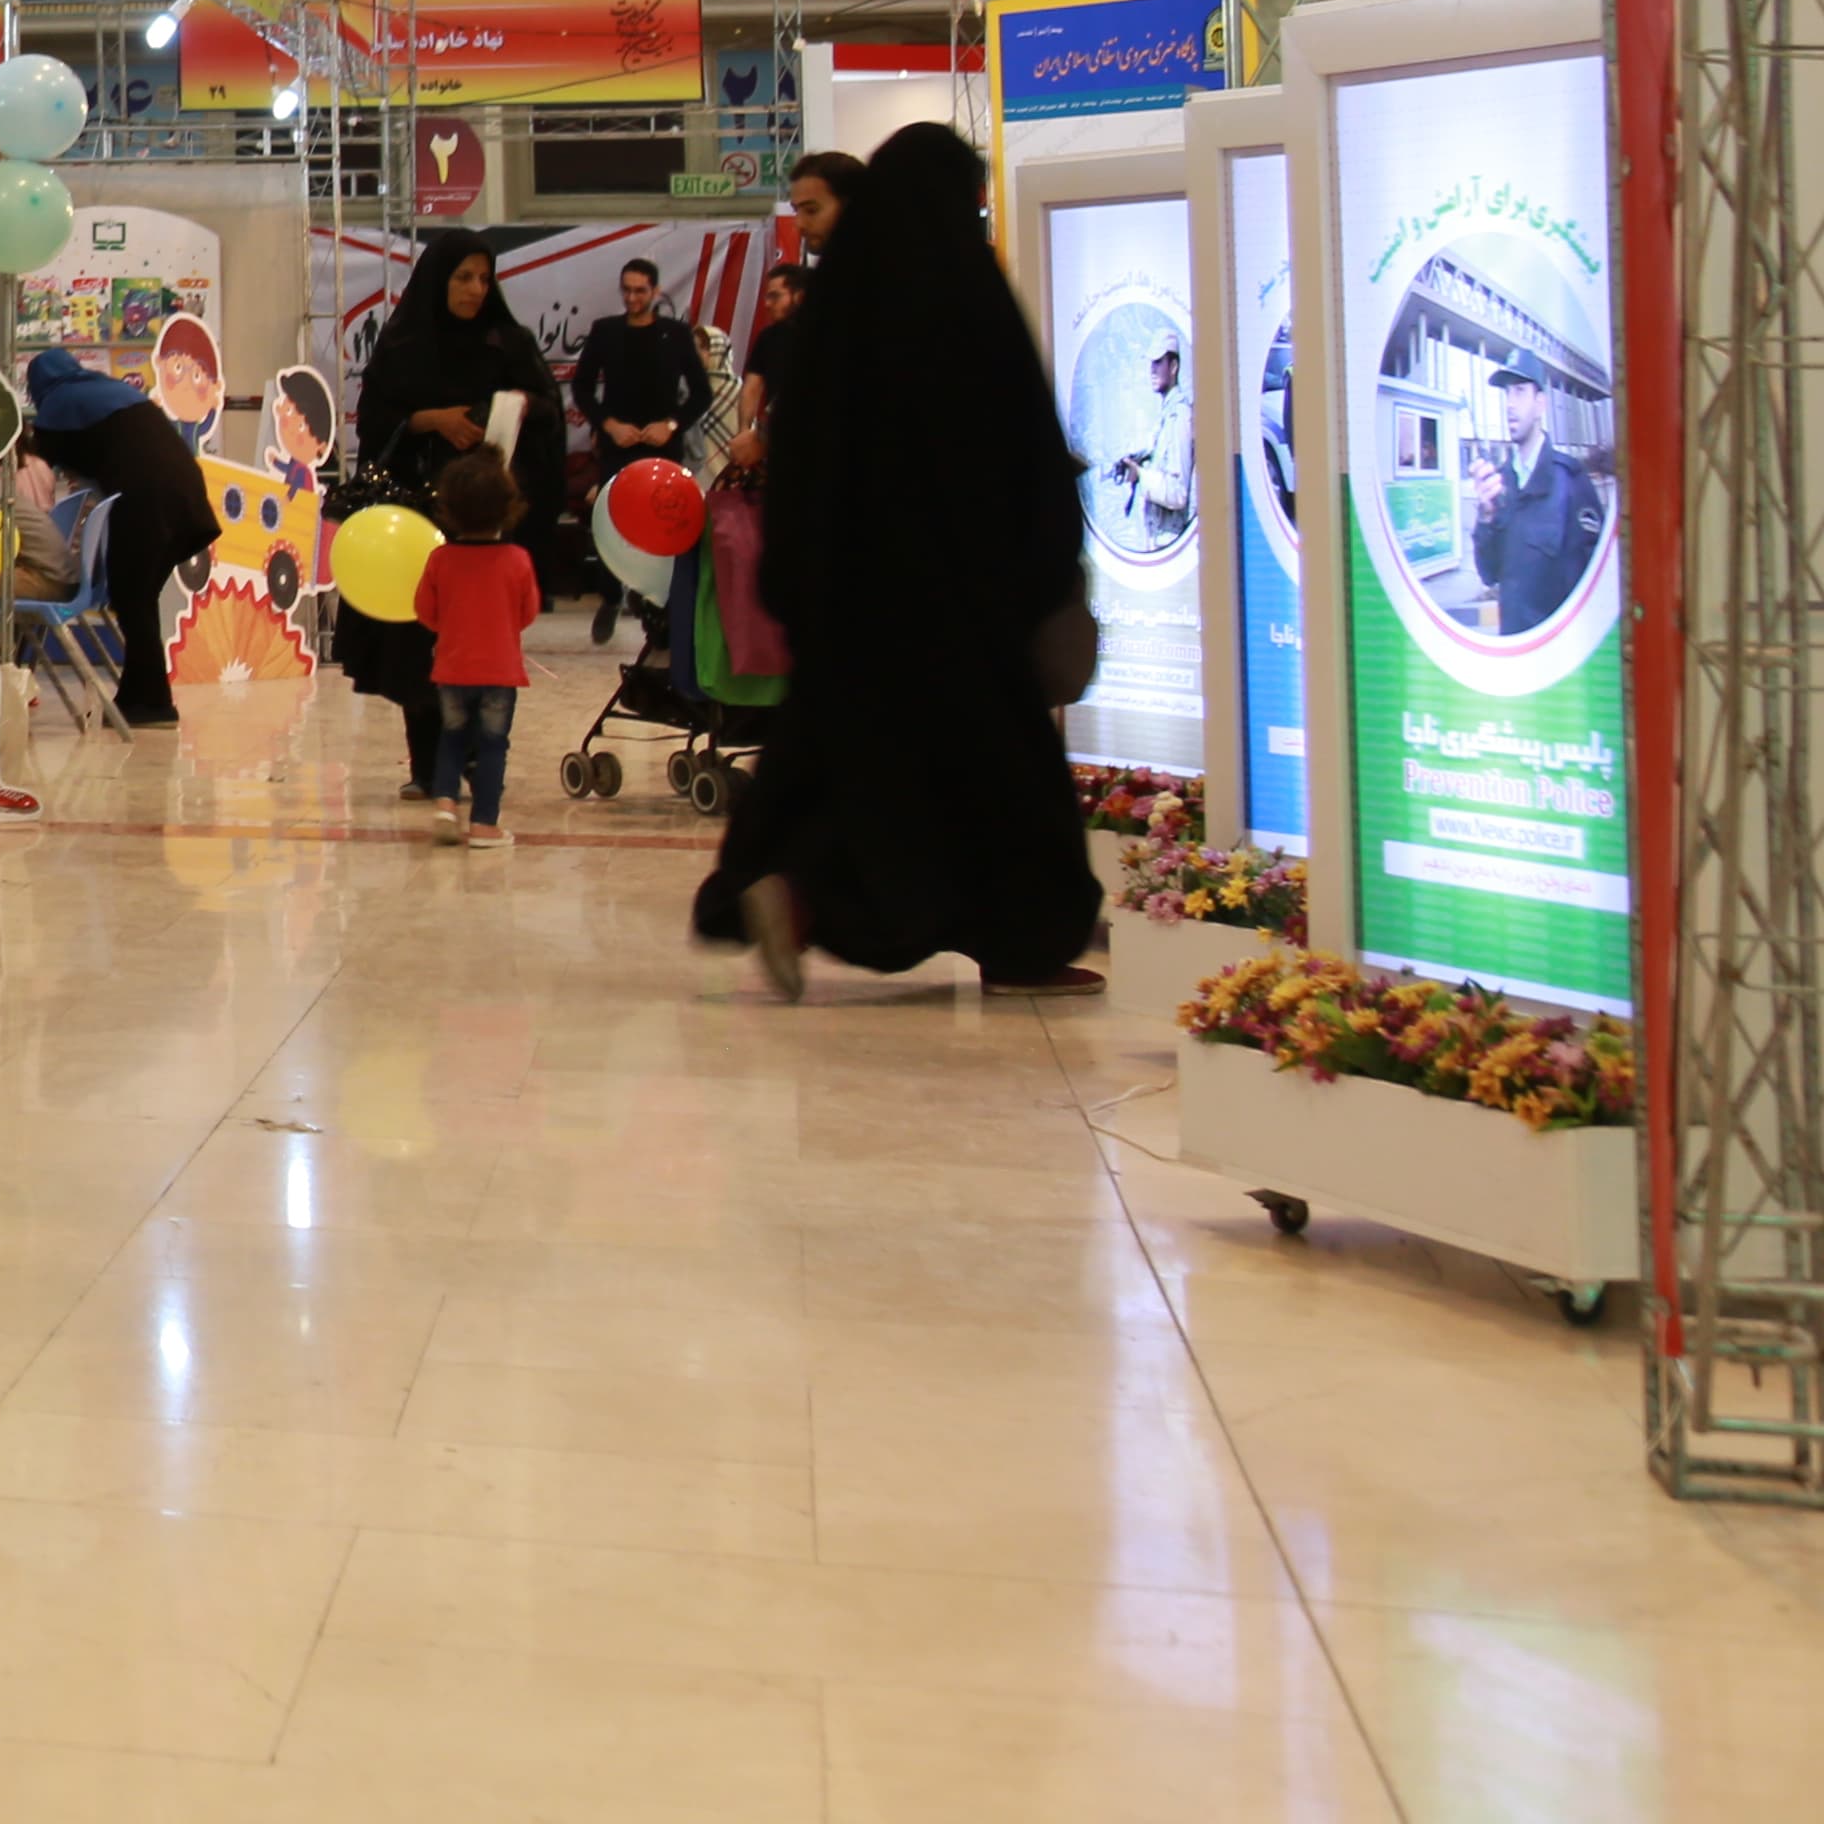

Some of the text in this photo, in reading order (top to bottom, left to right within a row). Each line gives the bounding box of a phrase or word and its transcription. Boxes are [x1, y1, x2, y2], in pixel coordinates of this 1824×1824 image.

[429, 131, 458, 185] ۲
[673, 176, 701, 194] EXIT
[1485, 180, 1529, 221] برای
[1401, 710, 1615, 782] پلیس پیشگیری ناجا
[1403, 757, 1615, 819] Prevention Police
